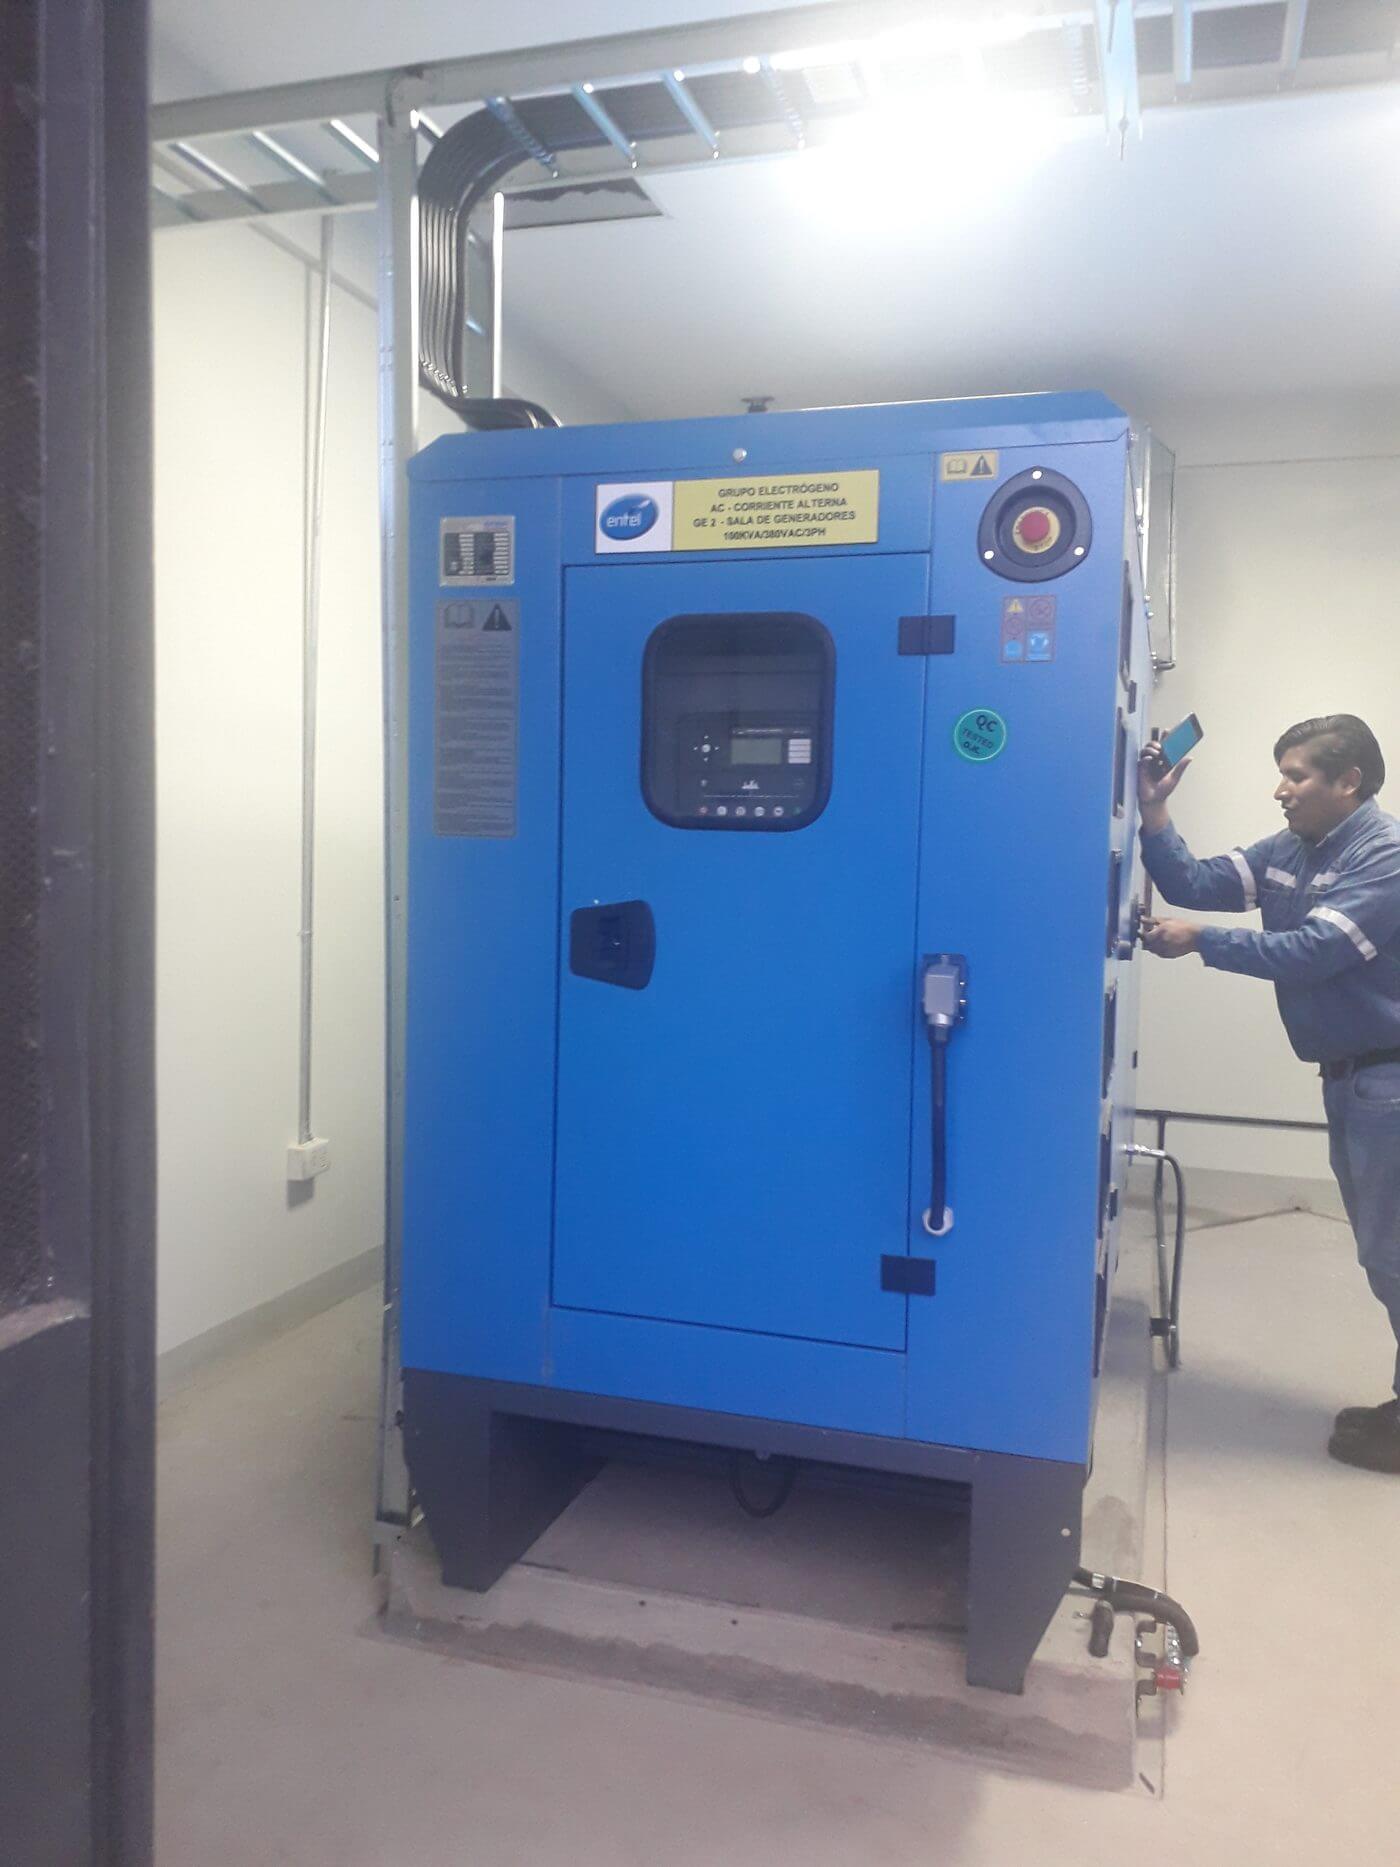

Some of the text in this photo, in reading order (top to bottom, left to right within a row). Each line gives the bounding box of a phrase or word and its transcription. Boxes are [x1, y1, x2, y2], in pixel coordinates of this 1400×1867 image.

[718, 487, 755, 498] GRUPO
[711, 504, 725, 513] AC
[734, 500, 794, 512] CORRIENTE
[797, 498, 847, 509] ALTERNA
[607, 512, 642, 528] entel
[693, 519, 707, 527] GE
[711, 519, 716, 527] 2
[727, 515, 753, 526] SALA
[757, 515, 770, 525] DE
[774, 510, 856, 524] GENERADORES
[976, 715, 997, 732] QC
